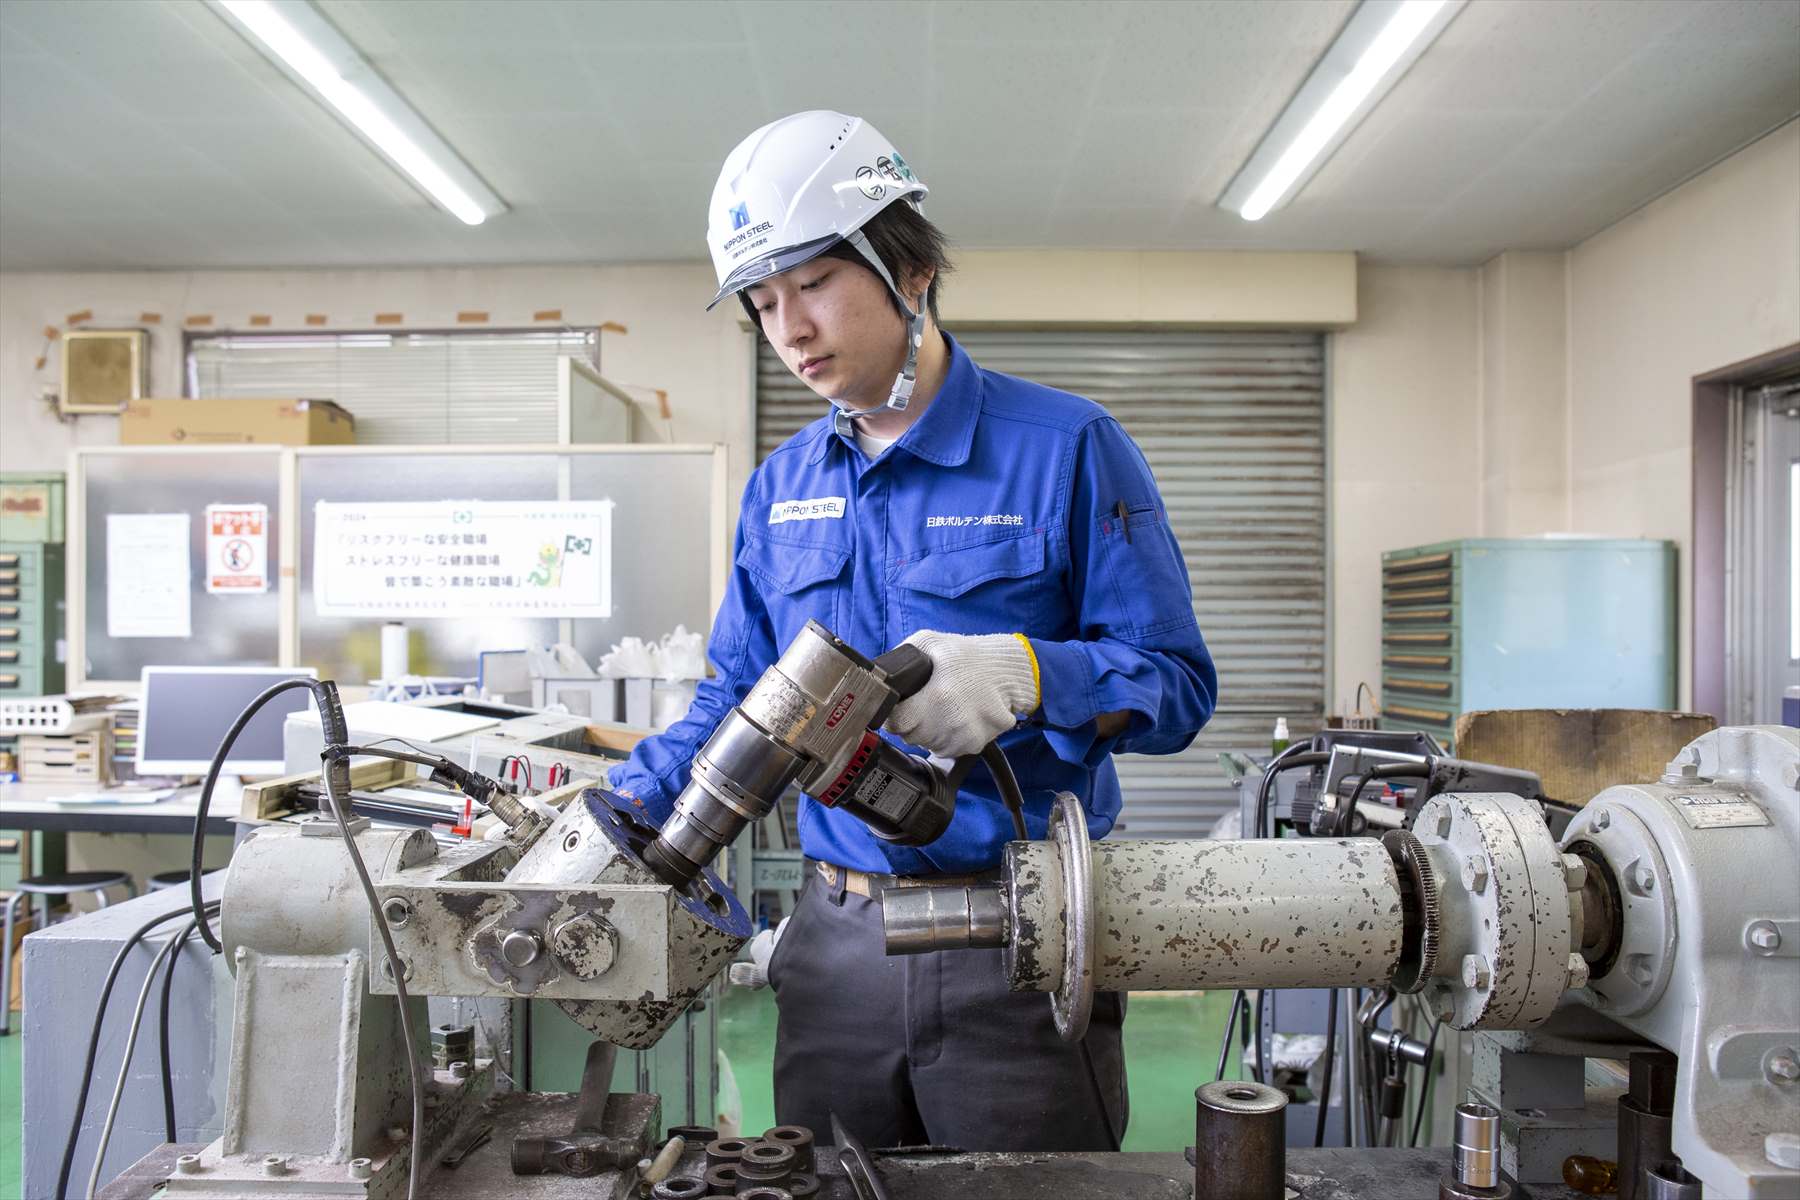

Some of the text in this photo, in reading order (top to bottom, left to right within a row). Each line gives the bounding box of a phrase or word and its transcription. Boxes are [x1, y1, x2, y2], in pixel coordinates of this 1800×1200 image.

[746, 220, 774, 238] STEEL
[926, 514, 1024, 528] 日鉄ボルテン株式会社
[828, 693, 855, 728] TONE
